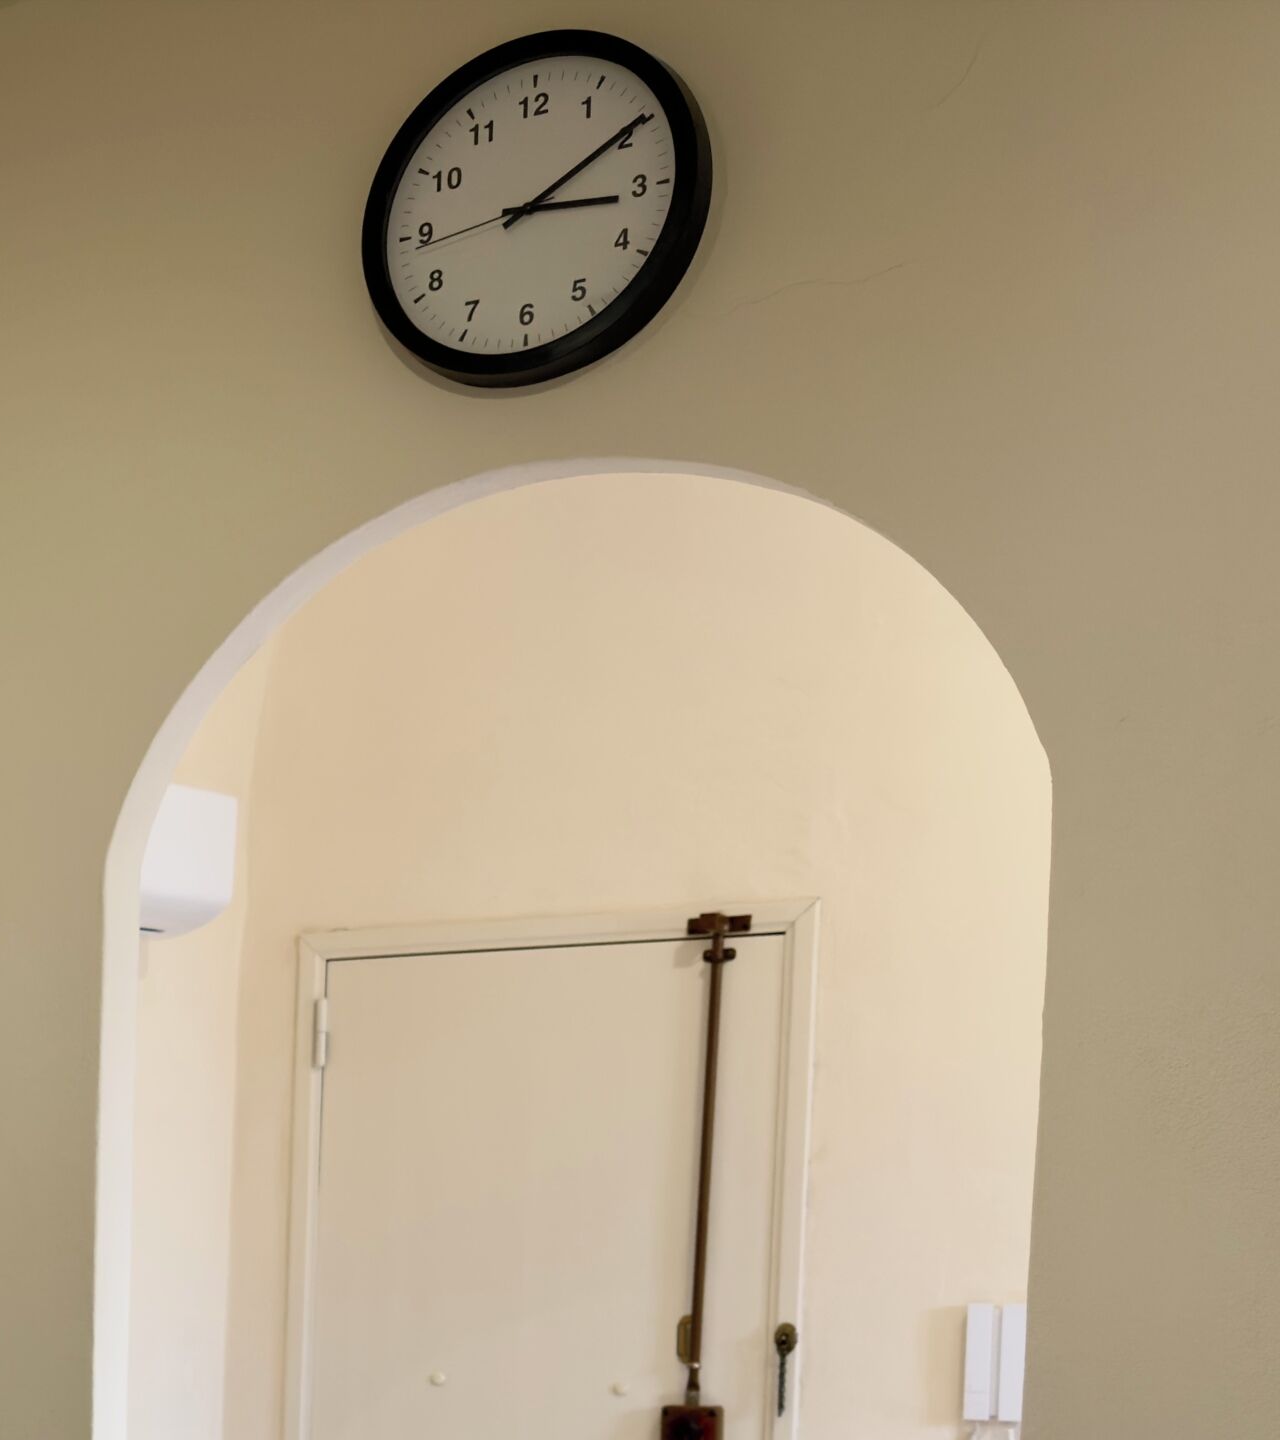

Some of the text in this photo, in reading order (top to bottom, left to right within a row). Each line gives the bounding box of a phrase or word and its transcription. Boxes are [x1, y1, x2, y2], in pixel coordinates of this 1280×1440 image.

[518, 93, 549, 119] 12
[581, 96, 593, 119] 1
[469, 120, 495, 145] 11
[617, 126, 634, 150] 2
[432, 167, 462, 192] 10
[631, 174, 648, 198] 3
[418, 222, 434, 245] 9
[613, 228, 630, 251] 4
[428, 270, 444, 291] 8
[570, 278, 587, 302] 5
[464, 299, 480, 322] 7
[518, 303, 535, 325] 6
